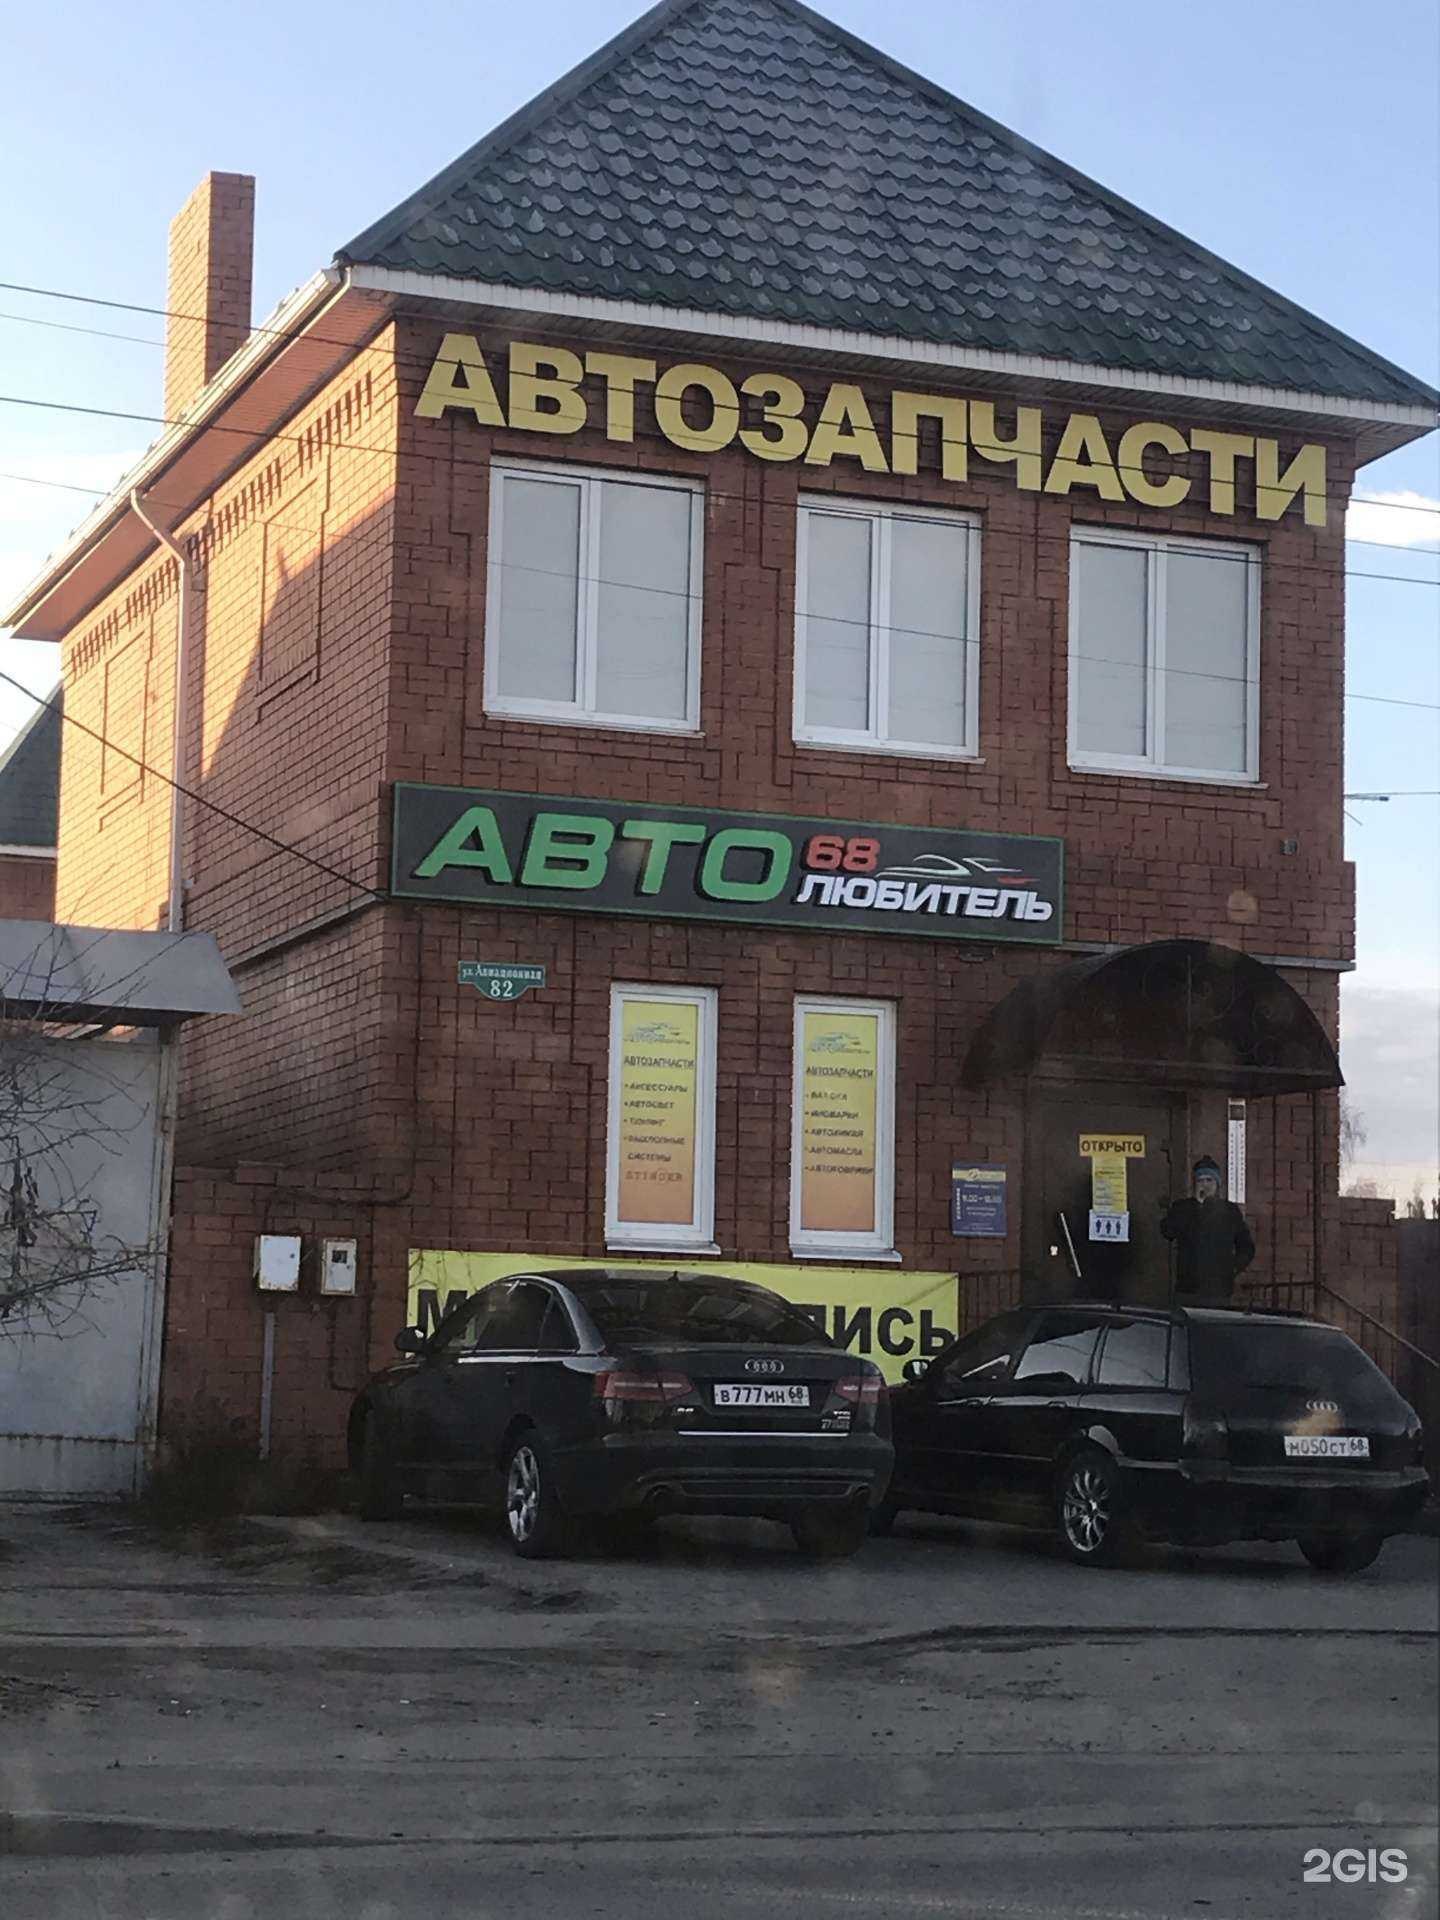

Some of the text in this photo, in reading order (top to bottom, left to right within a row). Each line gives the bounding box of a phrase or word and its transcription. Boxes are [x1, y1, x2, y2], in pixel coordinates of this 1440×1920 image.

[414, 333, 1327, 527] АВТОЗАПЧАСТИ
[412, 806, 793, 901] АВТО
[805, 834, 881, 872] 68
[797, 874, 1054, 921] ЛЮБИТЕЛЬ
[490, 980, 513, 997] 82
[624, 1055, 695, 1069] АВТОЗАПЧАСТИ
[806, 1065, 874, 1079] АВТОЗАПЧАСТИ
[1081, 1140, 1143, 1153] ОТКРЫТО
